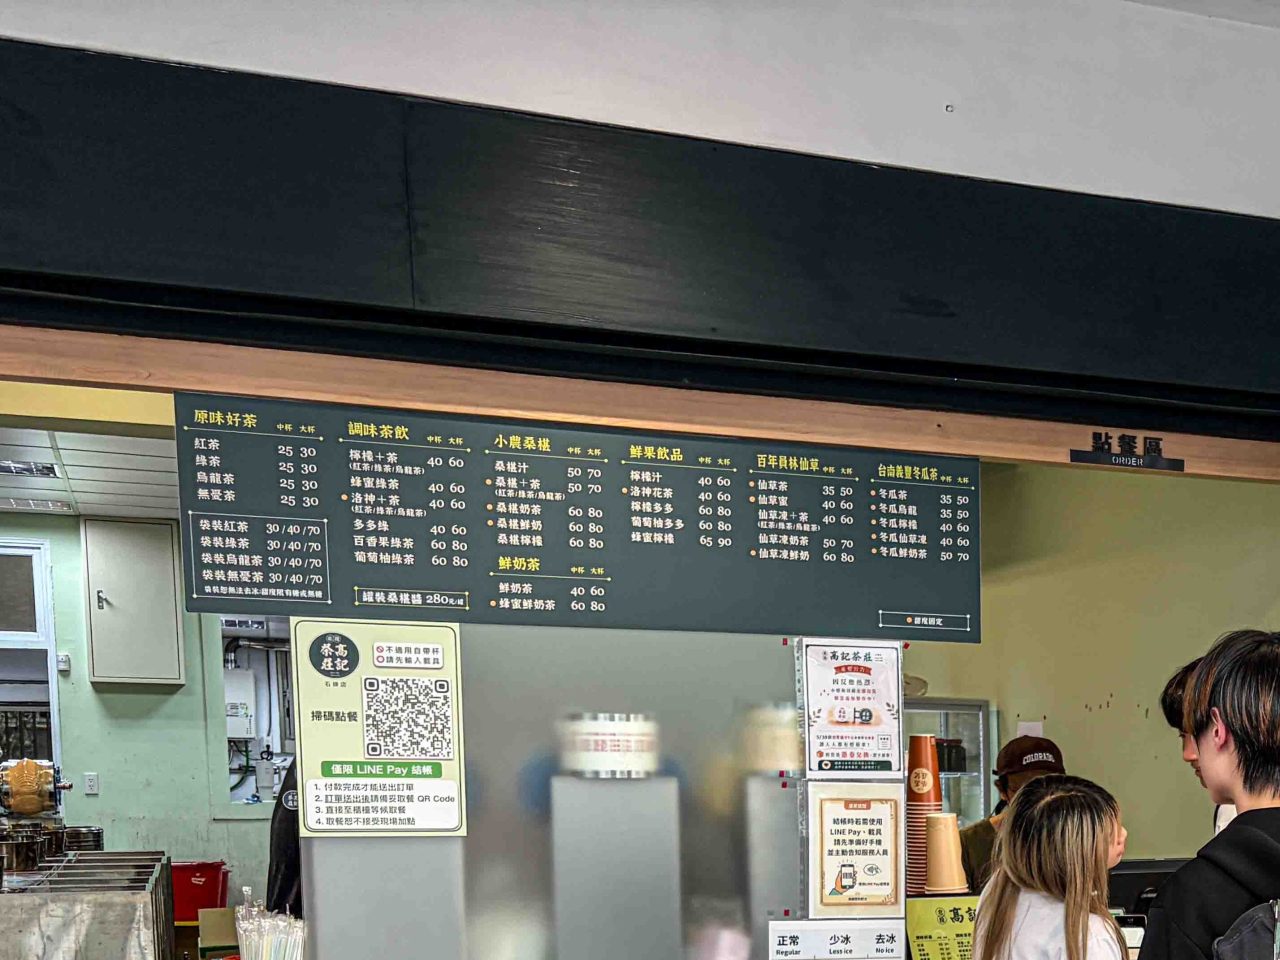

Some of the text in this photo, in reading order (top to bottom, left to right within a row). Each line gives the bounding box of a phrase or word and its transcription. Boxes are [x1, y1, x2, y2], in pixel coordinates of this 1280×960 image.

[194, 410, 257, 428] 原味好茶
[348, 422, 409, 440] 調味茶飲
[194, 438, 316, 458] 紅茶 25 30
[494, 434, 551, 452] 小農桑椹
[630, 445, 682, 460] 鮮果飲品
[196, 455, 317, 474] 綠茶 25 30
[427, 457, 442, 467] 40
[448, 457, 464, 467] 60
[757, 454, 819, 471] 百年員林仙草
[1112, 456, 1144, 466] ORDER
[568, 468, 581, 477] 50
[588, 469, 601, 479] 70
[197, 472, 318, 490] 烏龍茶 25 30
[350, 476, 465, 494] 蜂蜜綠茶 40 60
[568, 483, 582, 492] 50
[588, 484, 601, 494] 70
[630, 486, 672, 498] 洛神花茶
[758, 480, 852, 496] 仙草茶 35 50
[879, 488, 907, 500] 冬瓜茶
[281, 496, 296, 506] 25
[302, 497, 318, 507] 30
[429, 500, 444, 510] 40
[450, 499, 466, 509] 60
[496, 502, 541, 515] 桑椹奶茶
[200, 520, 248, 532] 袋裝紅茶
[353, 519, 466, 535] 多多綠 40 60
[200, 536, 249, 550] 袋裝綠茶
[353, 535, 468, 551] 百香果綠茶 60 80
[700, 535, 712, 546] 65
[718, 538, 732, 547] 90
[354, 551, 468, 566] 葡萄柚綠茶 60 80
[880, 546, 969, 562] 冬瓜鮮奶茶 50 70
[498, 556, 540, 571] 鮮奶茶
[499, 582, 532, 594] 鮮奶茶
[499, 598, 556, 610] 蜂蜜鮮奶茶
[311, 710, 358, 722] 掃碼點餐
[357, 766, 382, 774] LINE
[387, 766, 408, 776] Pay
[778, 936, 799, 946] 正常
[830, 934, 851, 946] 少冰
[875, 934, 896, 944] 去冰
